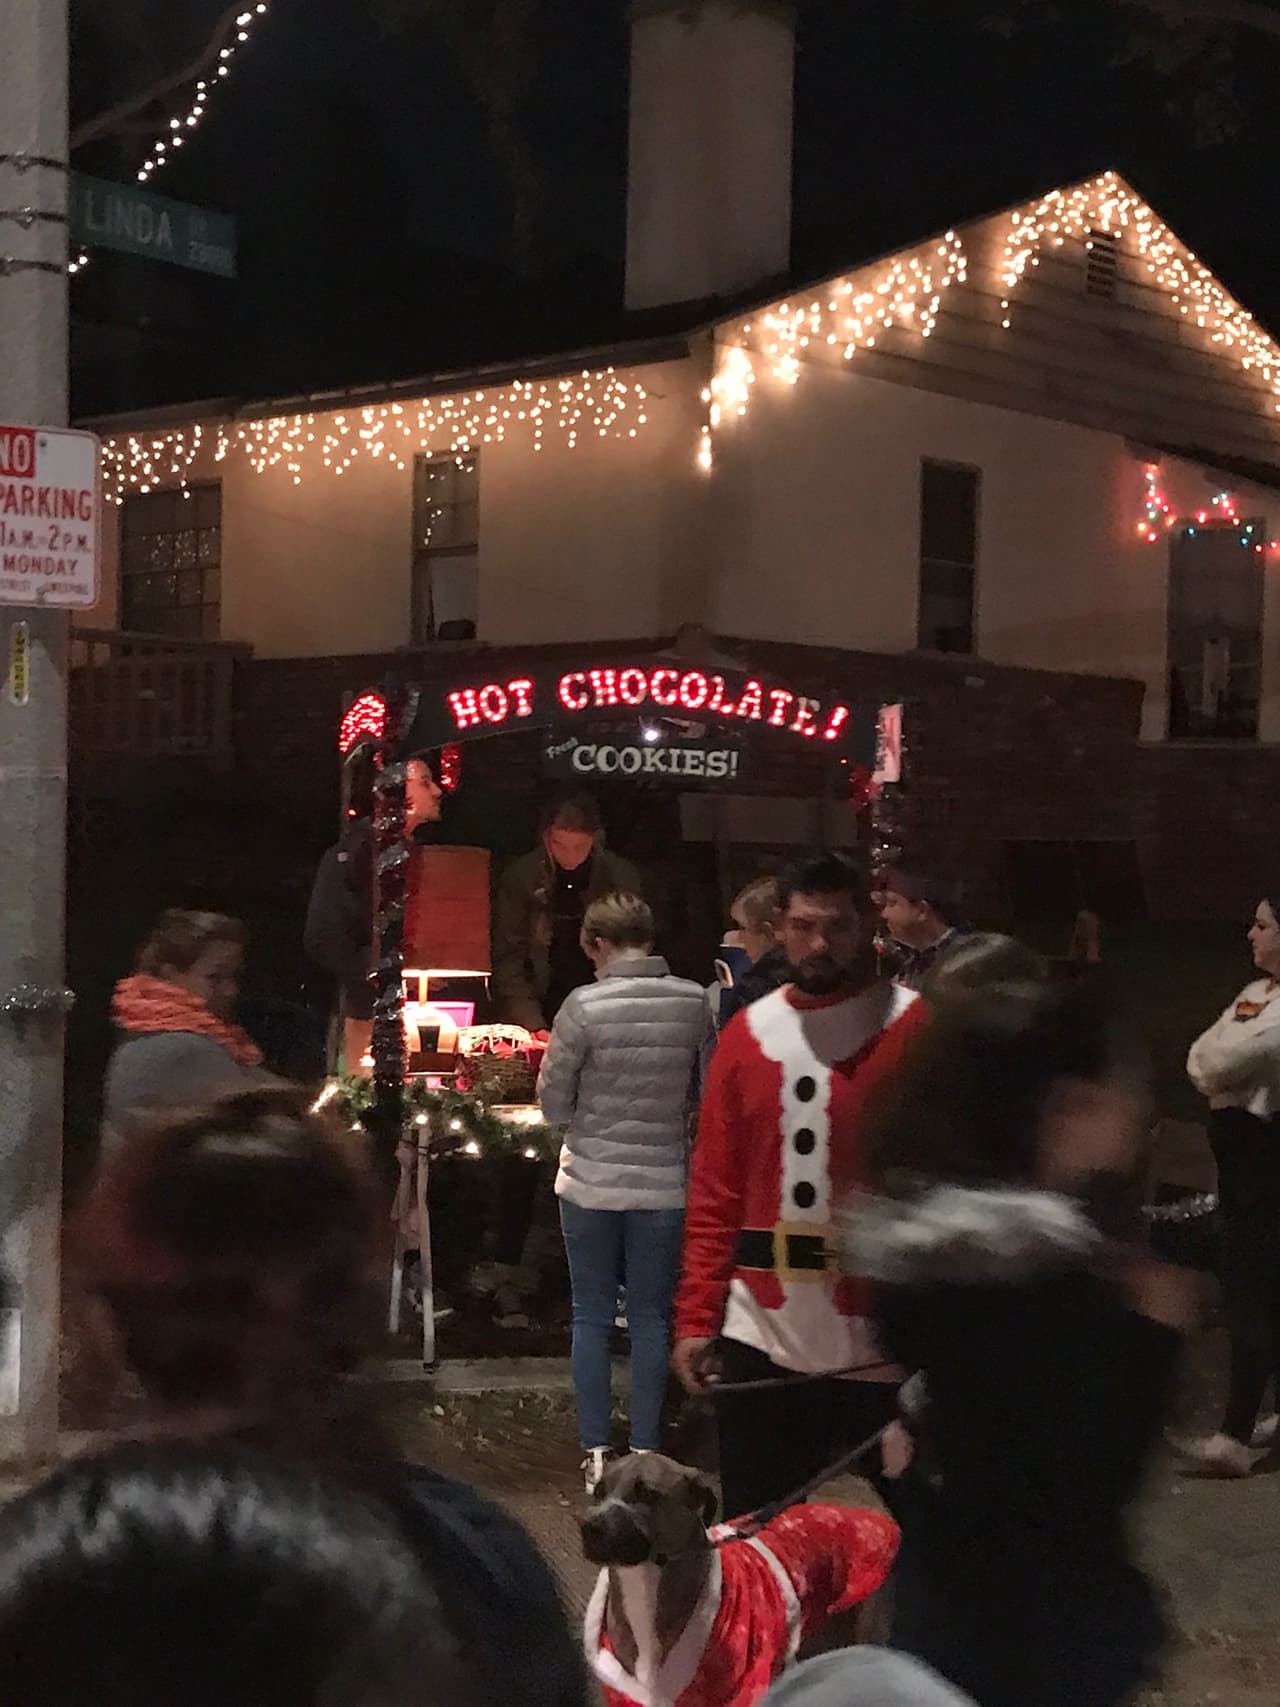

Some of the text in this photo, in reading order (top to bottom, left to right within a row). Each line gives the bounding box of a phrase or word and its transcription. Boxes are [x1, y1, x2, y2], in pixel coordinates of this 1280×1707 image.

[84, 188, 174, 249] LINDA
[0, 432, 31, 473] NO
[3, 553, 78, 575] MONDAY
[448, 667, 850, 740] HOT CHOCOLATE!
[572, 744, 739, 778] COOKIES!
